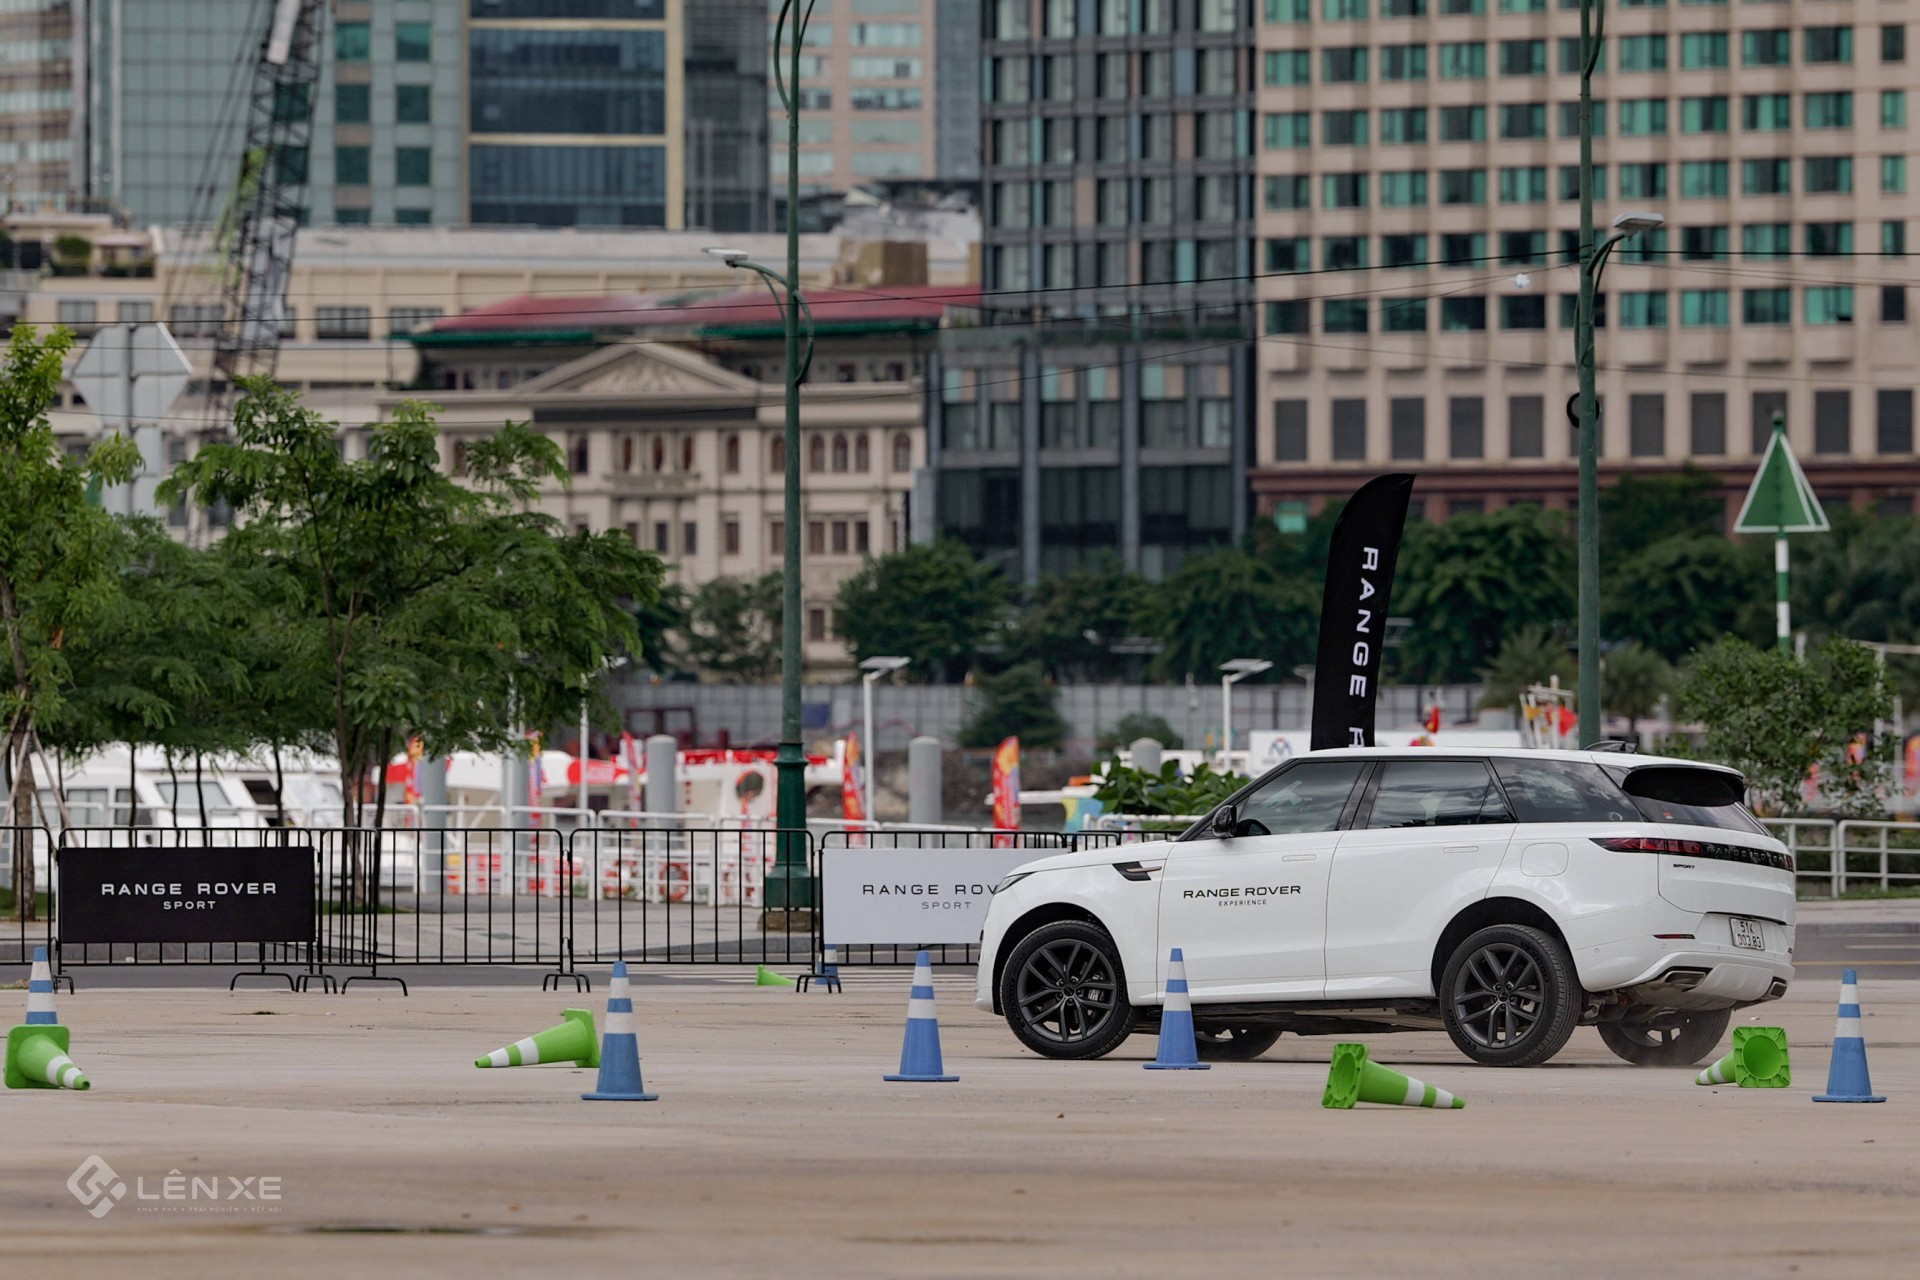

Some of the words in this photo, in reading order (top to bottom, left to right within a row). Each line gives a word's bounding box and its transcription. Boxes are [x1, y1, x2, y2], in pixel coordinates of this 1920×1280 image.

[1349, 546, 1379, 698] RANGE
[101, 883, 182, 896] RANGE
[197, 882, 277, 895] ROVER
[862, 884, 939, 895] RANGE
[954, 884, 999, 895] ROV
[1183, 888, 1240, 899] RANGE
[1244, 885, 1301, 896] ROVER
[163, 900, 216, 910] SPORT
[921, 901, 972, 910] SPORT
[1218, 899, 1267, 907] EXPERIENCE
